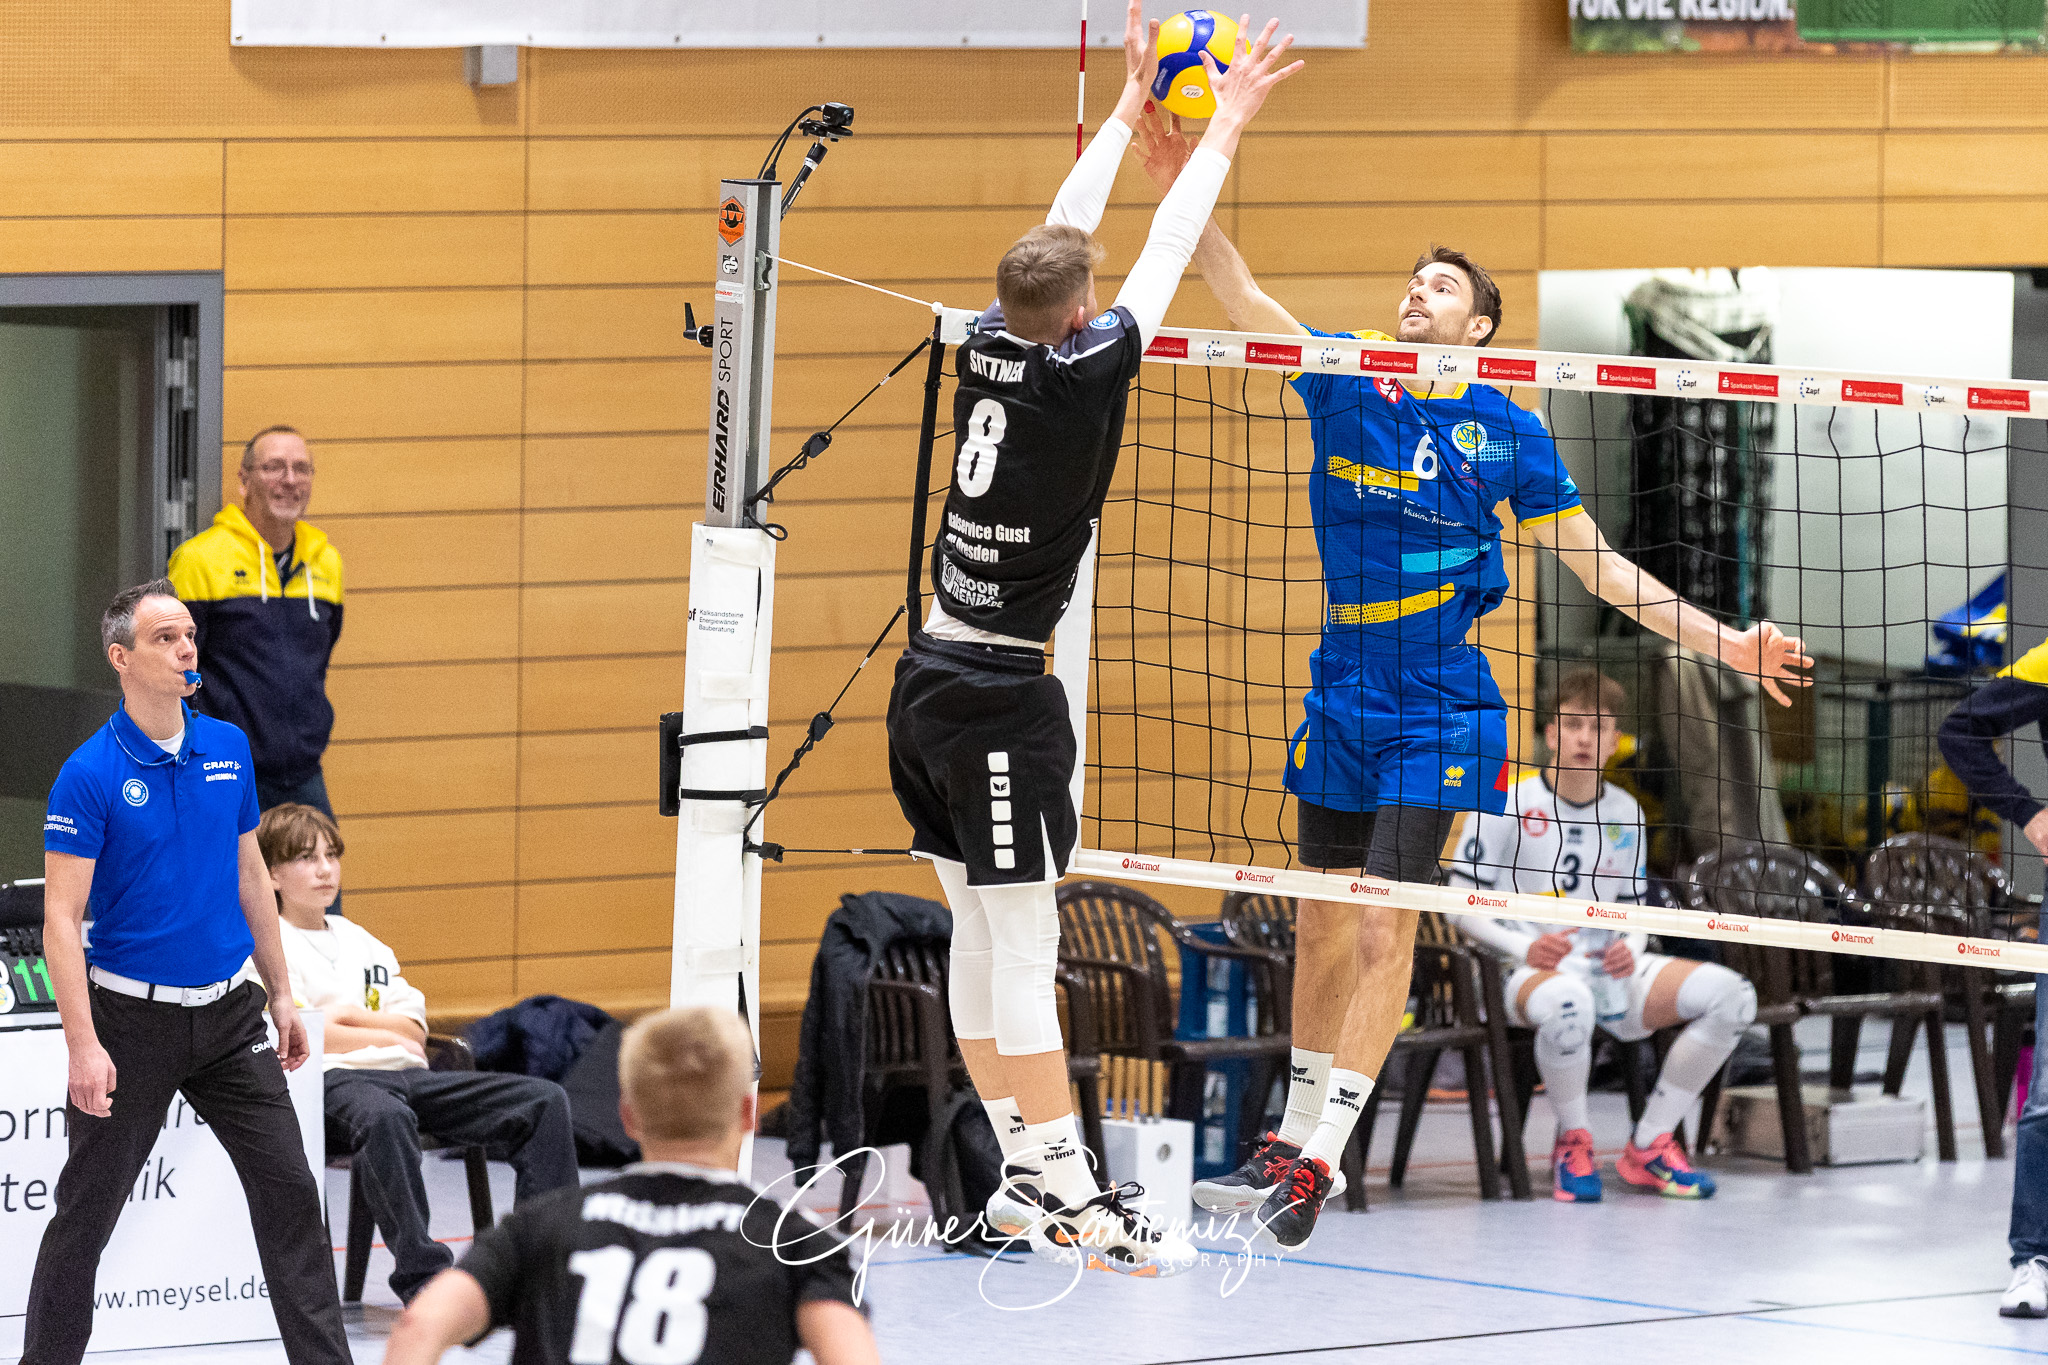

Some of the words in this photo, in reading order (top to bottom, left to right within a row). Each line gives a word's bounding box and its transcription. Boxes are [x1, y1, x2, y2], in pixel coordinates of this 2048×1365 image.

[718, 317, 734, 383] SPORT
[1211, 349, 1225, 358] Zapf
[1257, 351, 1277, 360] Sparkasse
[1326, 357, 1340, 365] Zapf
[1371, 359, 1393, 368] Sparkasse
[1443, 364, 1457, 373] Zapf
[1489, 366, 1510, 375] Sparkasse
[1562, 372, 1576, 380] Zapf
[1609, 374, 1630, 382] Sparkasse
[1682, 379, 1697, 388] Zapf
[1730, 381, 1752, 390] Sparkasse
[1806, 386, 1820, 395] Zapf
[1853, 389, 1876, 398] Sparkasse
[1980, 397, 2002, 406] Sparkasse
[713, 388, 730, 514] ERHARD
[957, 399, 1007, 497] 8
[1413, 431, 1440, 480] 6
[995, 524, 1031, 543] Gust
[699, 609, 744, 618] Kalksandsteine
[699, 616, 739, 625] Energiewände
[698, 624, 735, 634] Bauberatung
[202, 760, 234, 770] CRAFT
[1130, 860, 1160, 872] Marmot
[1243, 872, 1274, 883] Marmot
[1561, 853, 1582, 892] 3
[1358, 884, 1390, 896] Marmot
[1476, 896, 1508, 908] Marmot
[1595, 908, 1627, 920] Marmot
[1716, 921, 1749, 933] Marmot
[1840, 932, 1874, 945] Marmot
[1967, 945, 2001, 957] Marmot
[13, 958, 56, 1001] 11
[1329, 1096, 1361, 1112] erima
[1043, 1149, 1076, 1162] erima
[568, 1245, 717, 1365] 18
